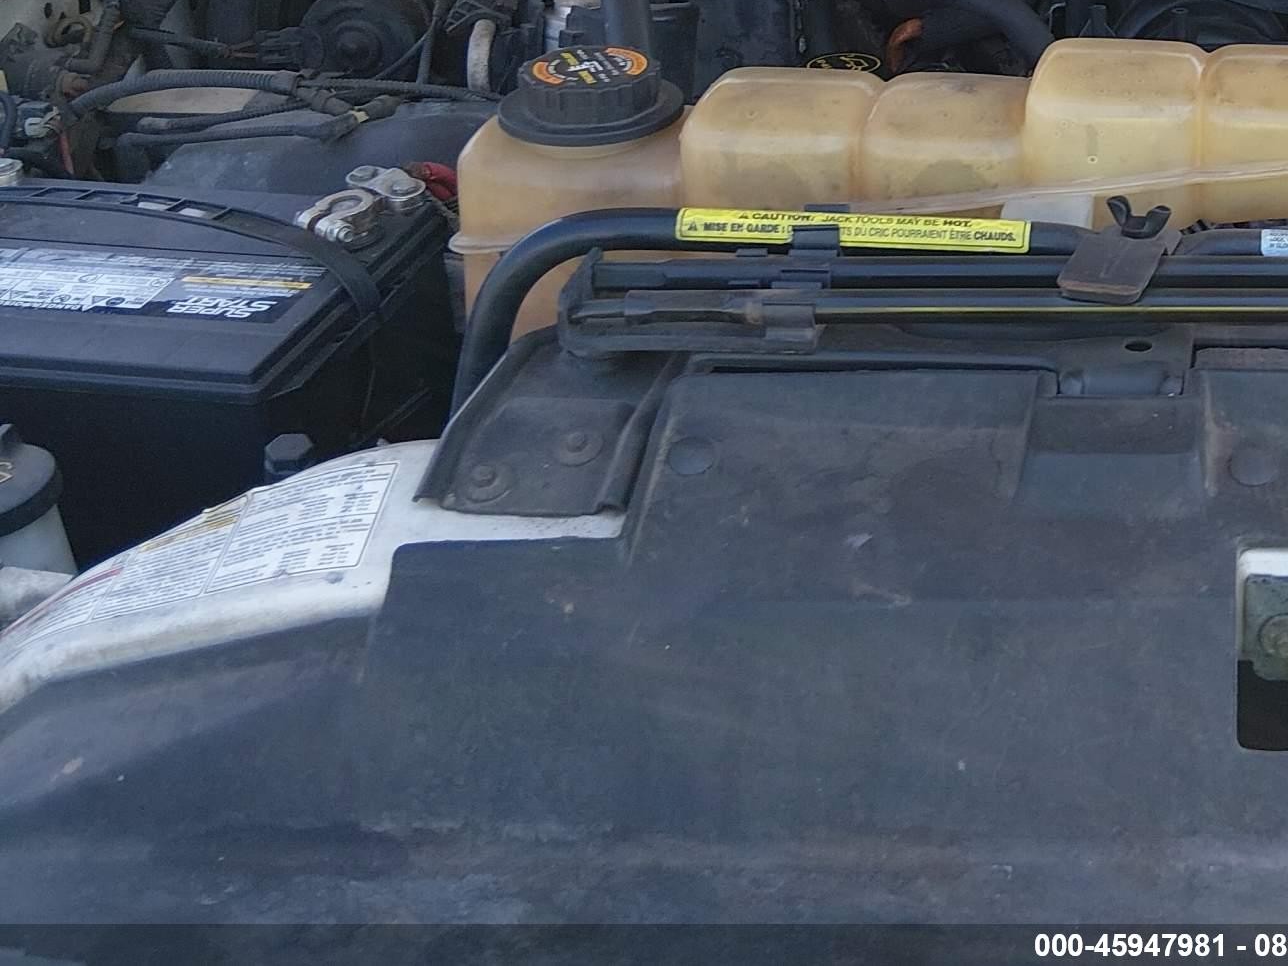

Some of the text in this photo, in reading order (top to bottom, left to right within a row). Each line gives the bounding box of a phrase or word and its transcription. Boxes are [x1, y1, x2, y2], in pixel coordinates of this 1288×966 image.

[703, 222, 728, 232] MISE
[822, 215, 854, 223] JACK
[856, 216, 894, 225] TOOLS
[895, 217, 922, 226] MAY
[923, 218, 940, 227] BE
[176, 296, 278, 312] START
[166, 305, 253, 318] SUPER
